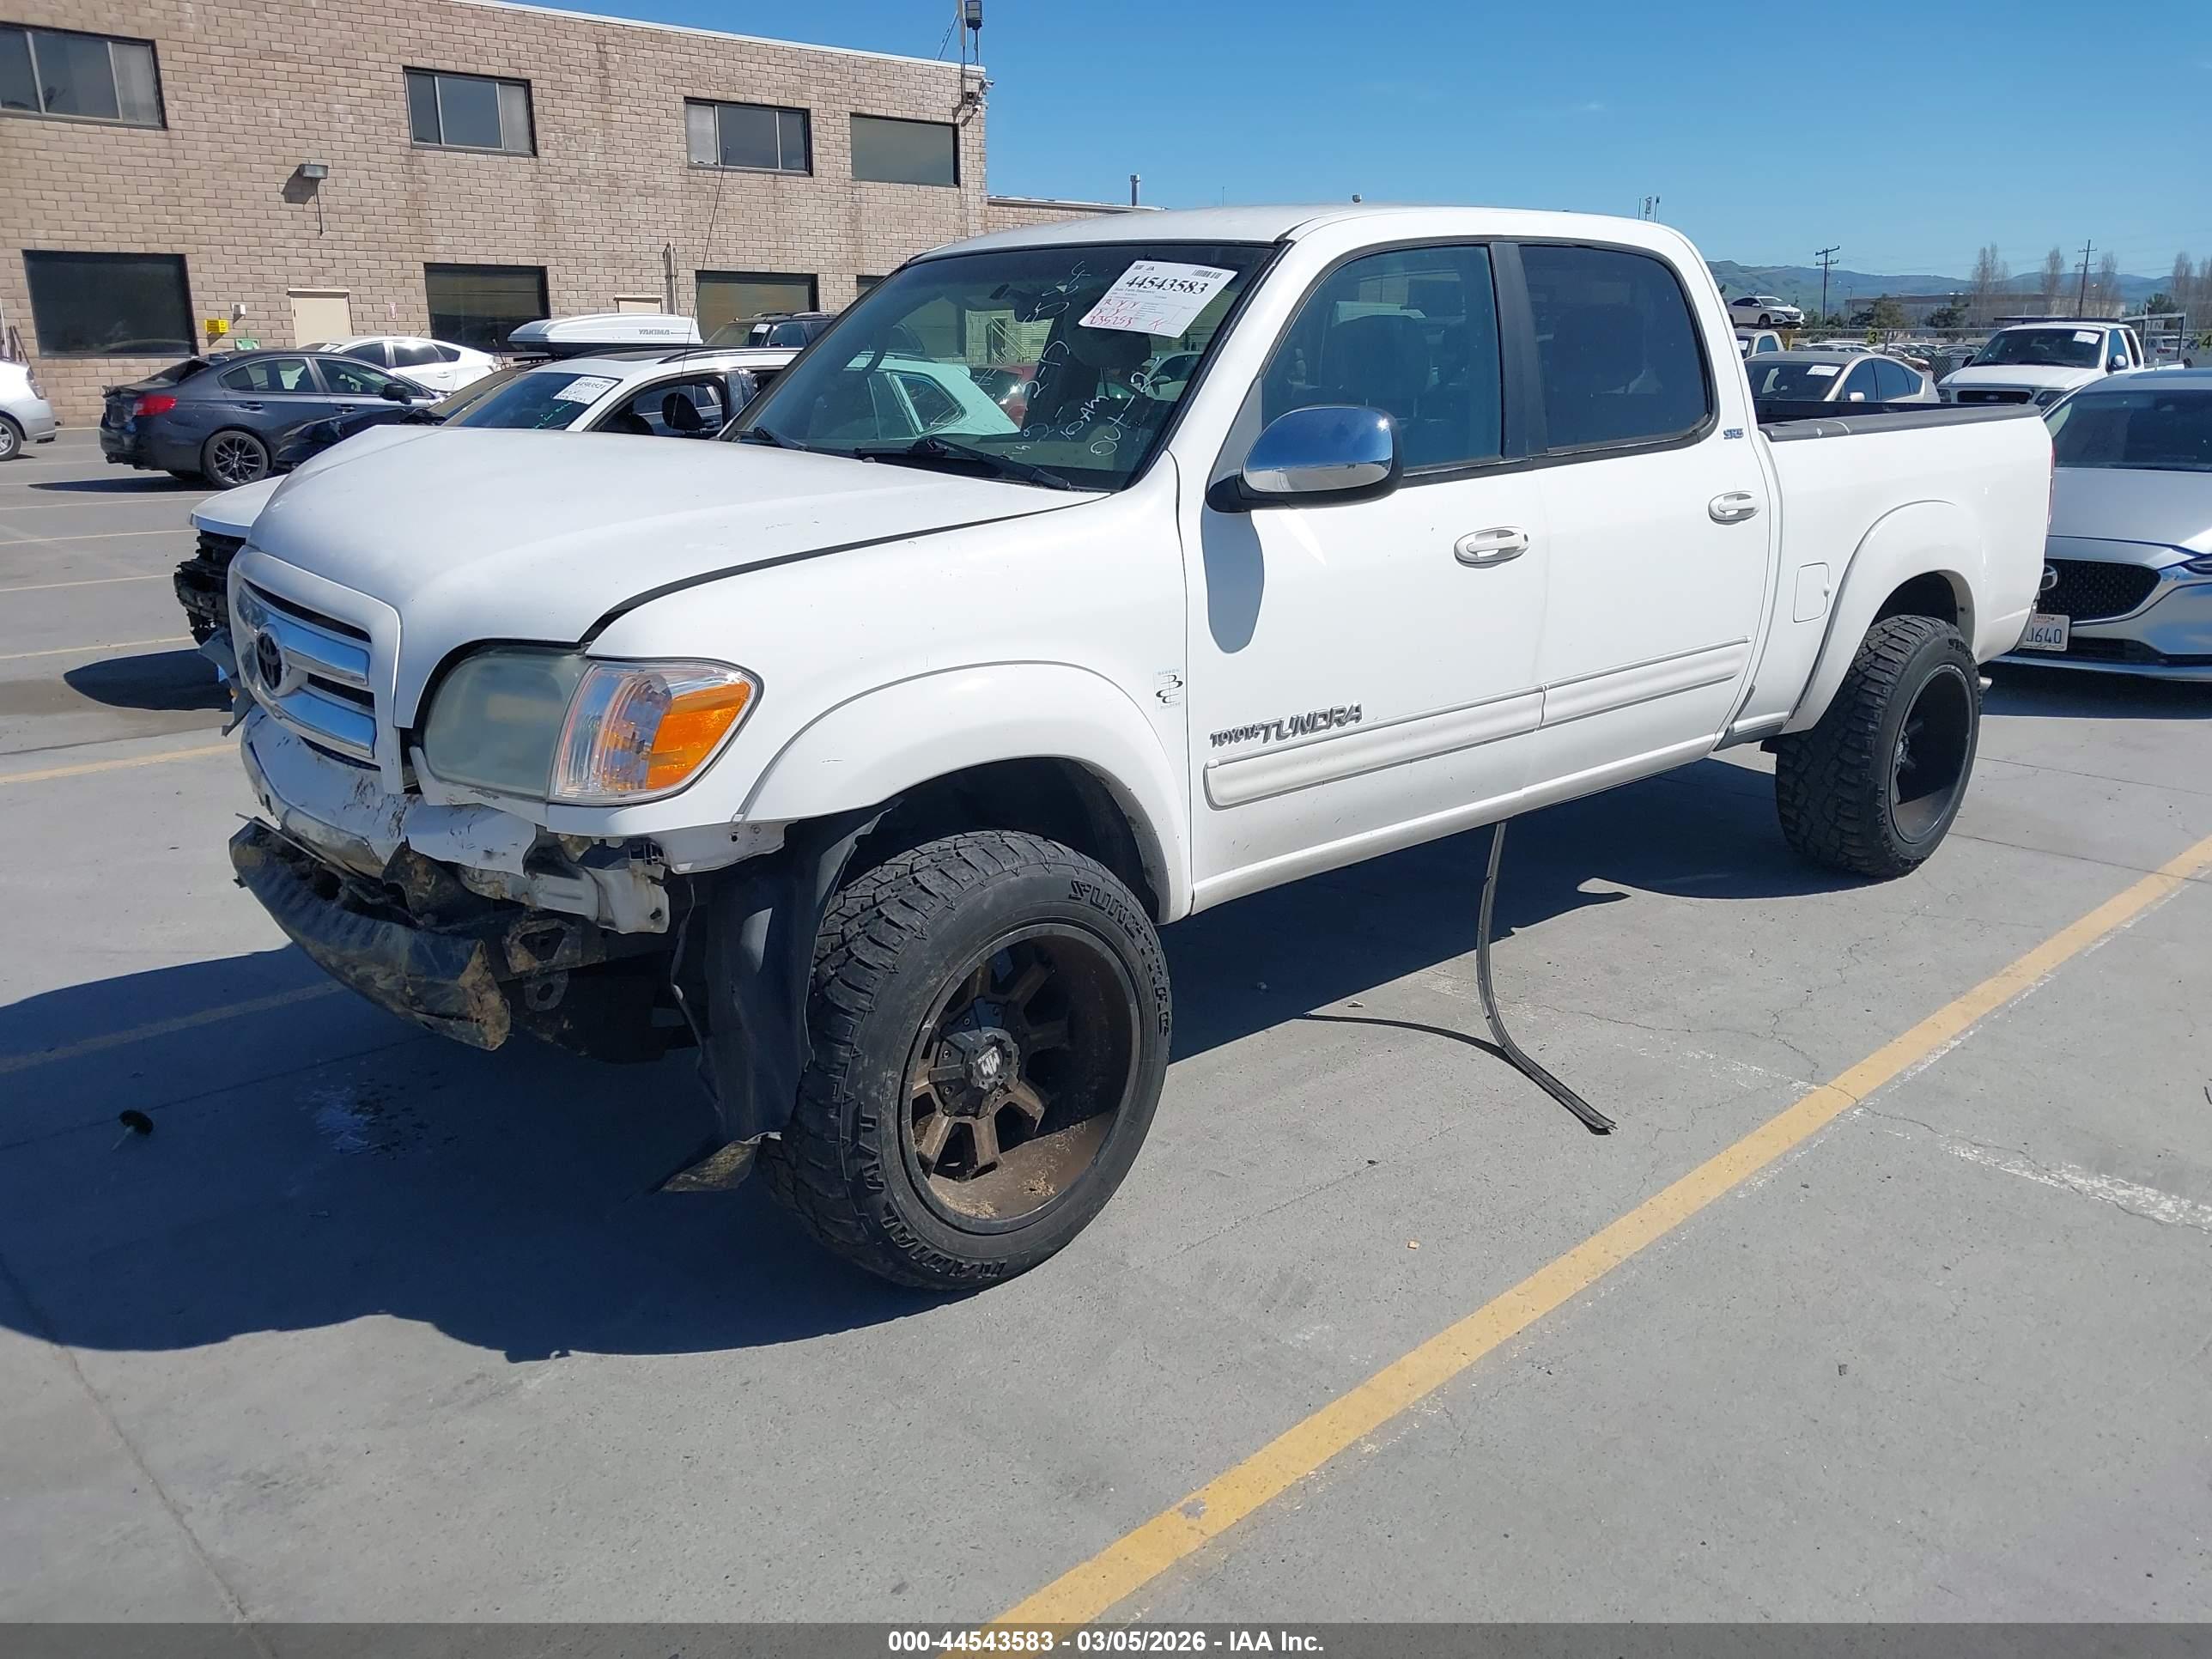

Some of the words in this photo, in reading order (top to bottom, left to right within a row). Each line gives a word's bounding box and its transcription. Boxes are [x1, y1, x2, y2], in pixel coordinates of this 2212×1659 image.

[1126, 275, 1208, 295] 44543583
[1869, 331, 1877, 343] 3
[2202, 334, 2212, 349] 4
[1209, 725, 1261, 748] TOYOTA
[1258, 702, 1363, 744] TUNDRA
